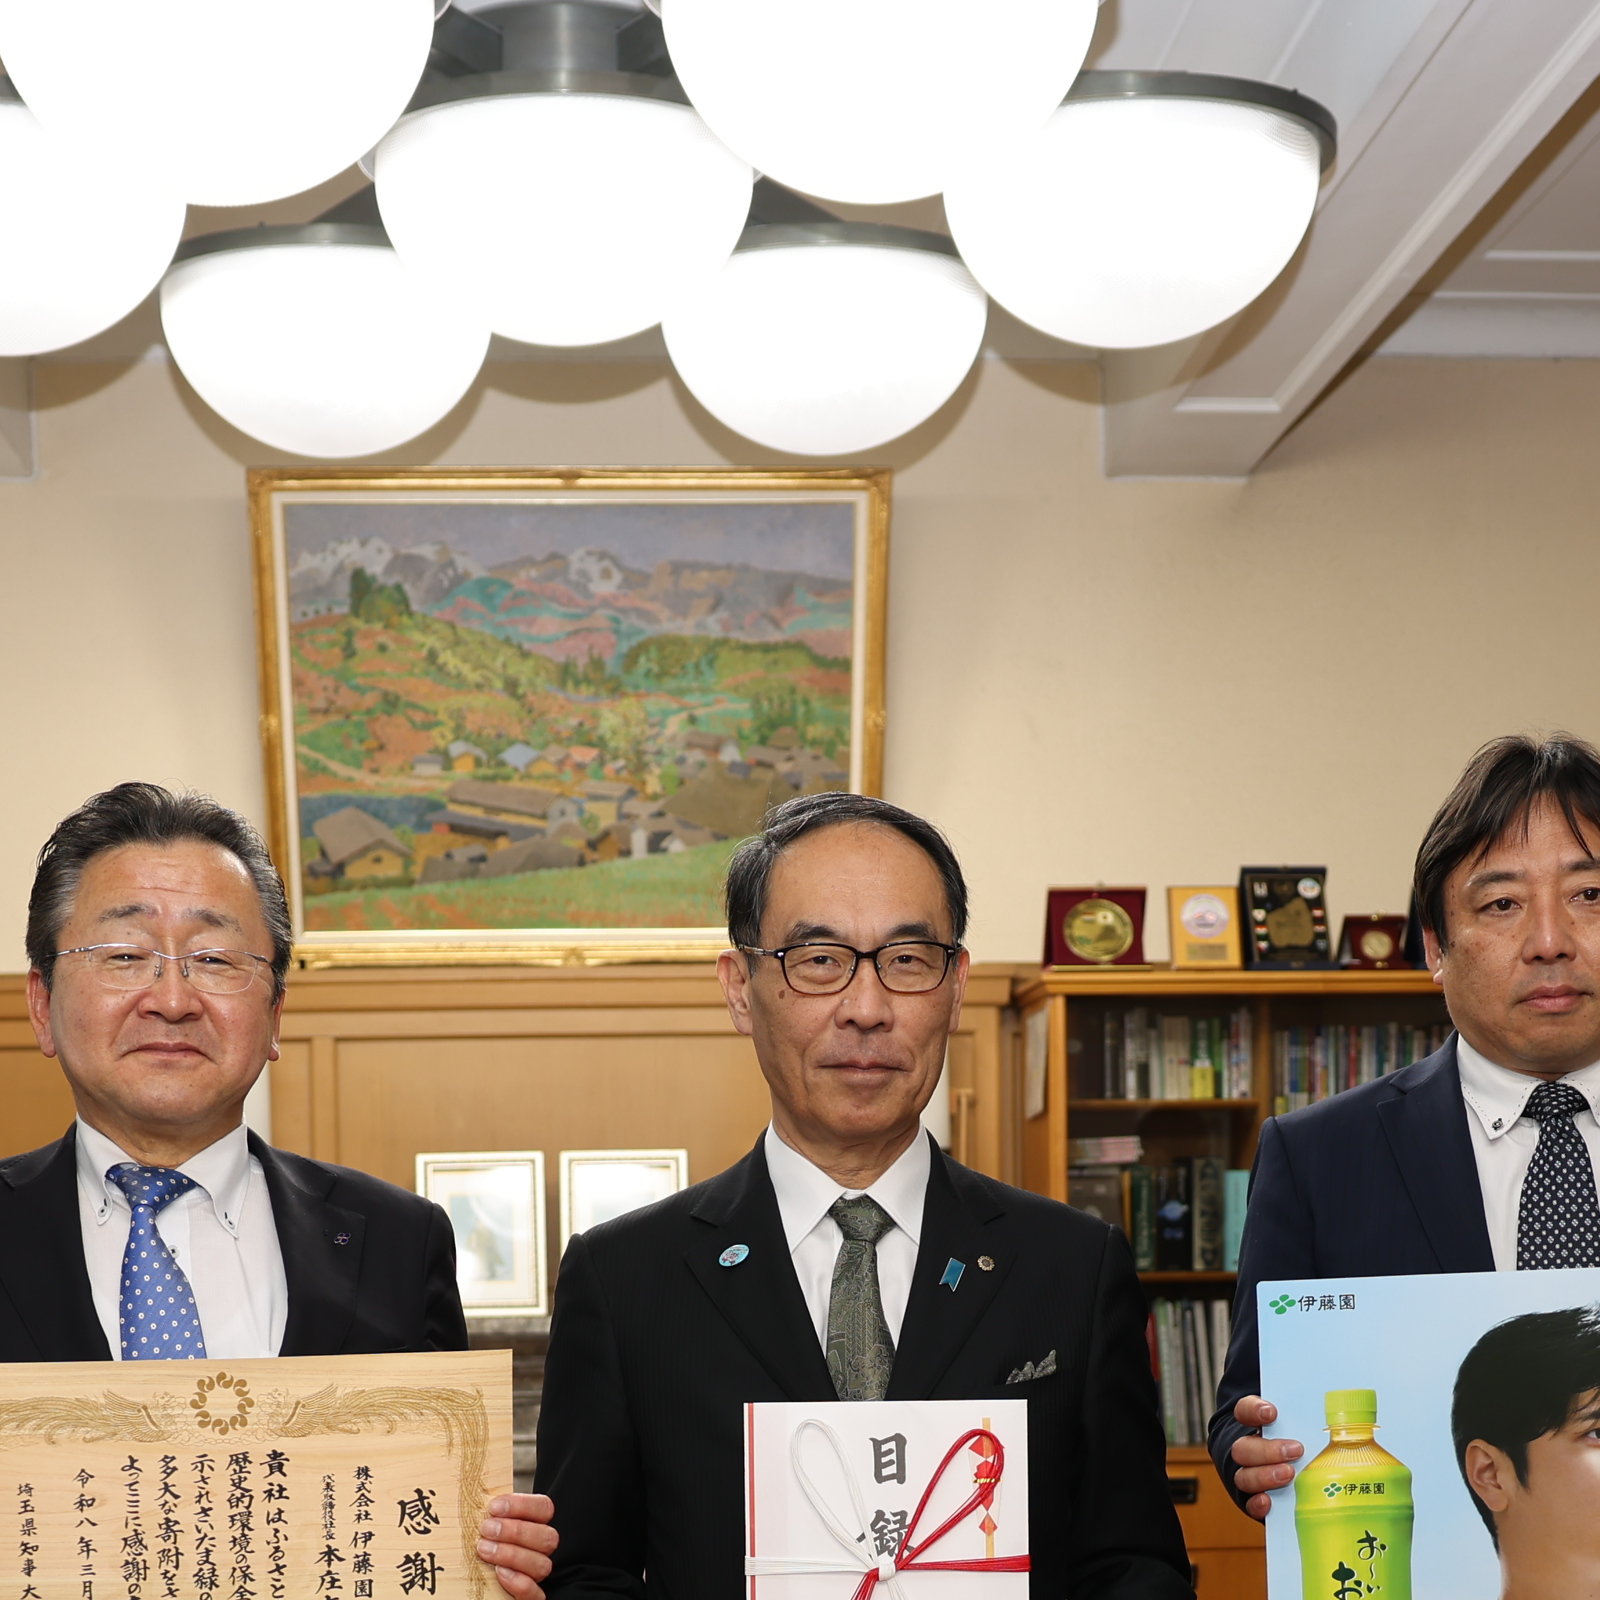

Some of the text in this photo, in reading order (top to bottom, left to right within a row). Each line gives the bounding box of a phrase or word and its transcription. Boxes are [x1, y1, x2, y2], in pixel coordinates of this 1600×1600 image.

[1297, 1293, 1356, 1312] 伊藤園
[855, 1432, 915, 1560] 目録
[1343, 1482, 1385, 1496] 伊藤園
